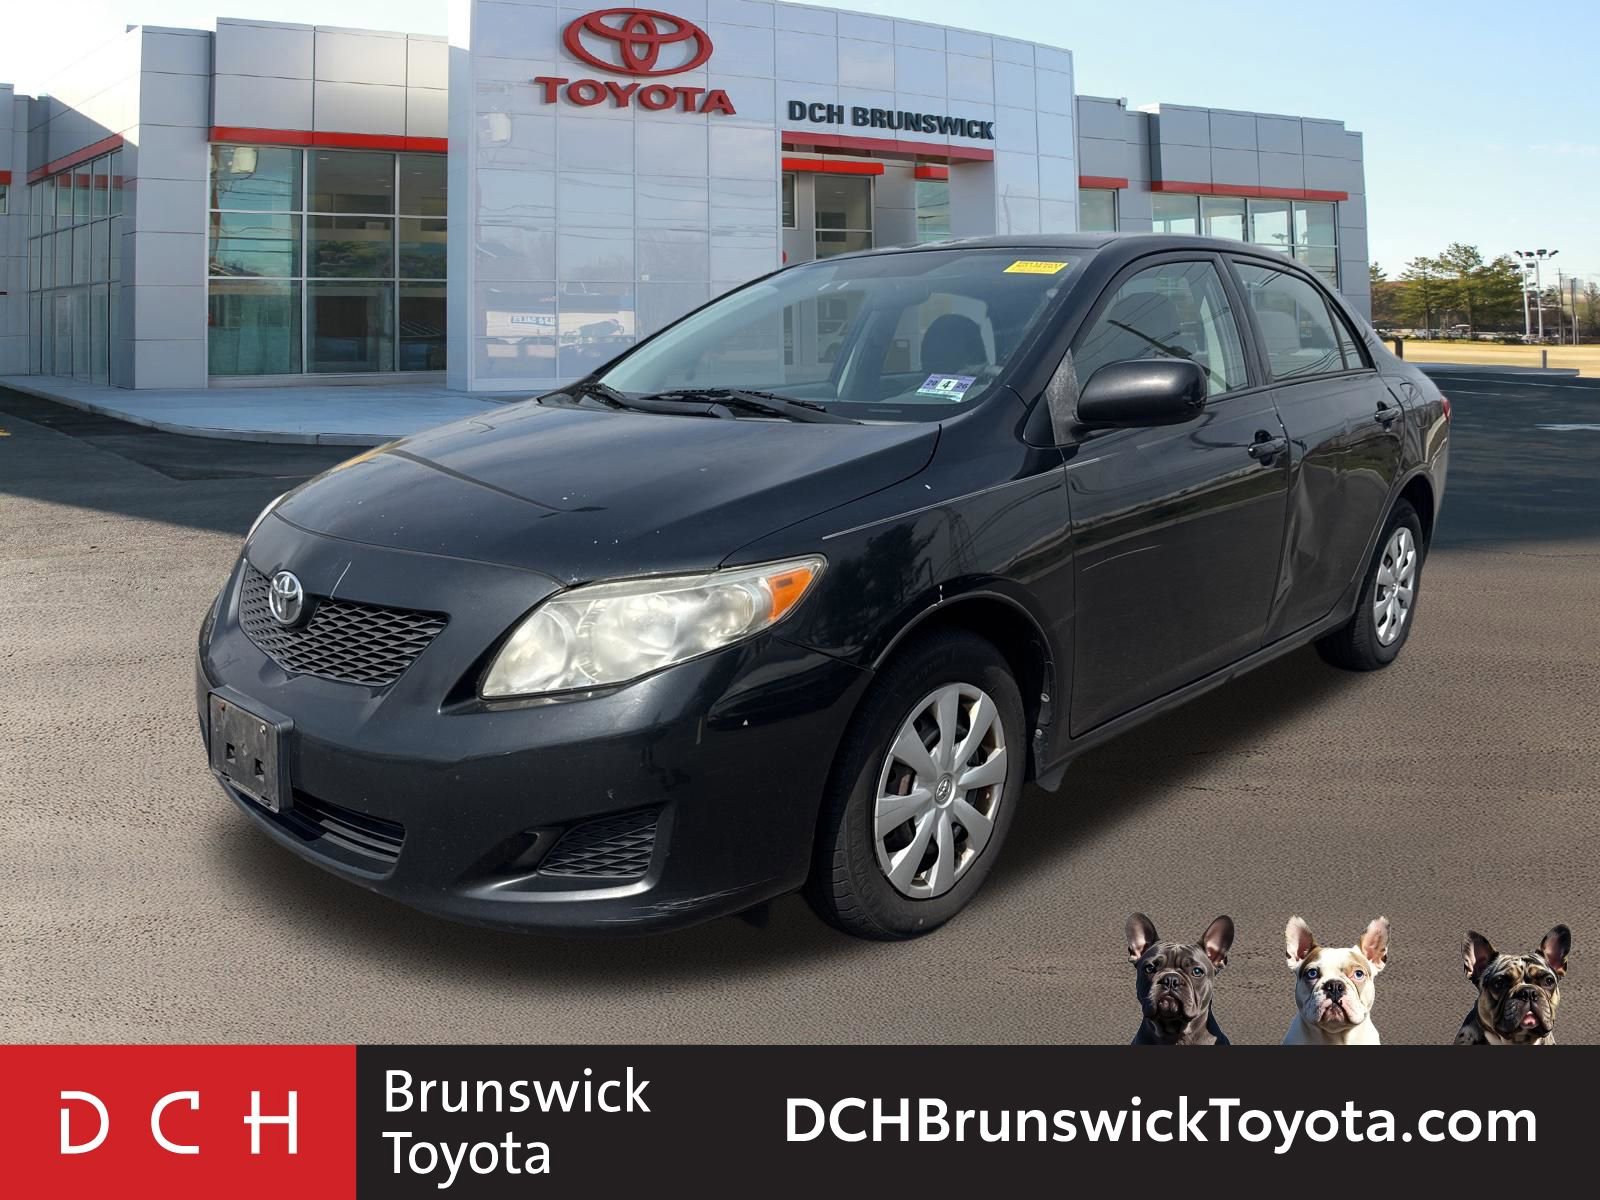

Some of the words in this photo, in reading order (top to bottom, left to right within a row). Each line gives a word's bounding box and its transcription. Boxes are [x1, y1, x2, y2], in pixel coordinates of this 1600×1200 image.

[534, 76, 736, 116] TOYOTA
[788, 100, 845, 124] DCH
[851, 106, 995, 140] BRUNSWICK
[942, 381, 952, 389] 4
